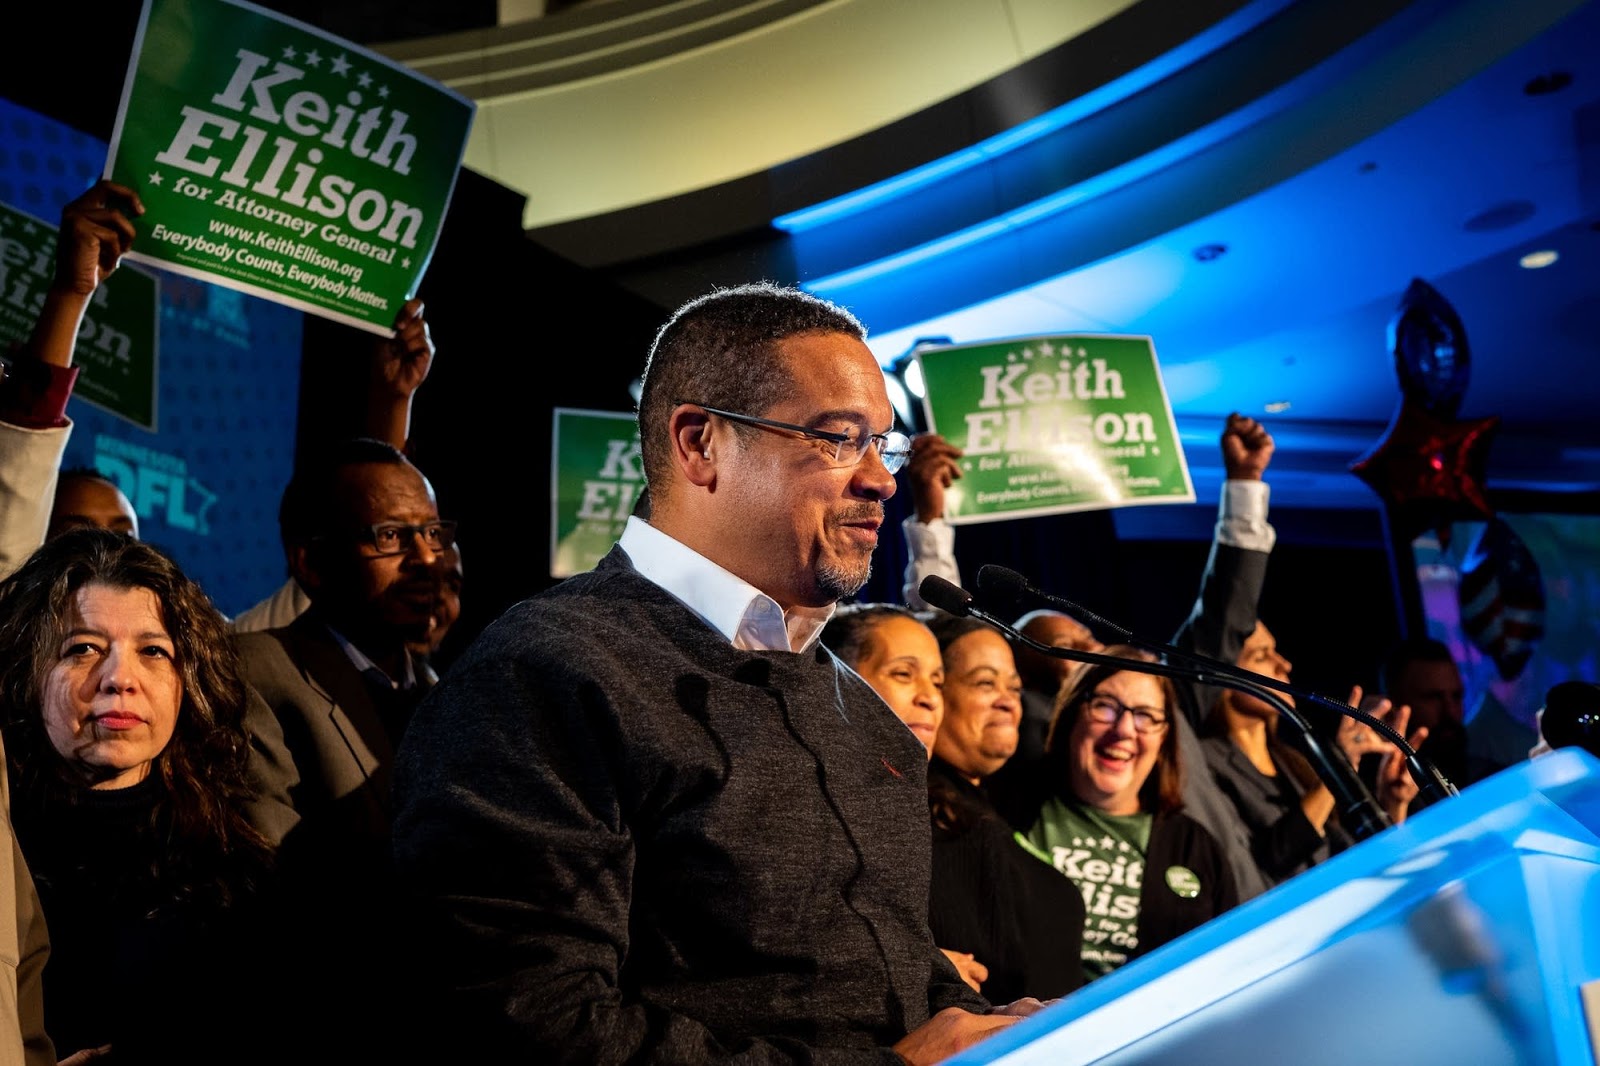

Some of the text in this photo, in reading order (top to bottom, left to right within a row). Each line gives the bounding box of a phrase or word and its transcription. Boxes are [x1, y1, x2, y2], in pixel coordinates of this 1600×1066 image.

[212, 49, 417, 176] Keith
[155, 105, 423, 249] Ellison
[173, 176, 396, 264] for Attorney General
[208, 219, 363, 282] www.KeithEllison.org
[152, 224, 235, 262] Everybody
[236, 249, 285, 278] Counts,
[287, 264, 348, 298] Everybody
[979, 358, 1125, 409] Keith
[964, 407, 1157, 456] Ellison
[979, 453, 1001, 471] for
[95, 454, 198, 532] DFL
[1052, 845, 1144, 889] Keit
[1098, 918, 1121, 932] for
